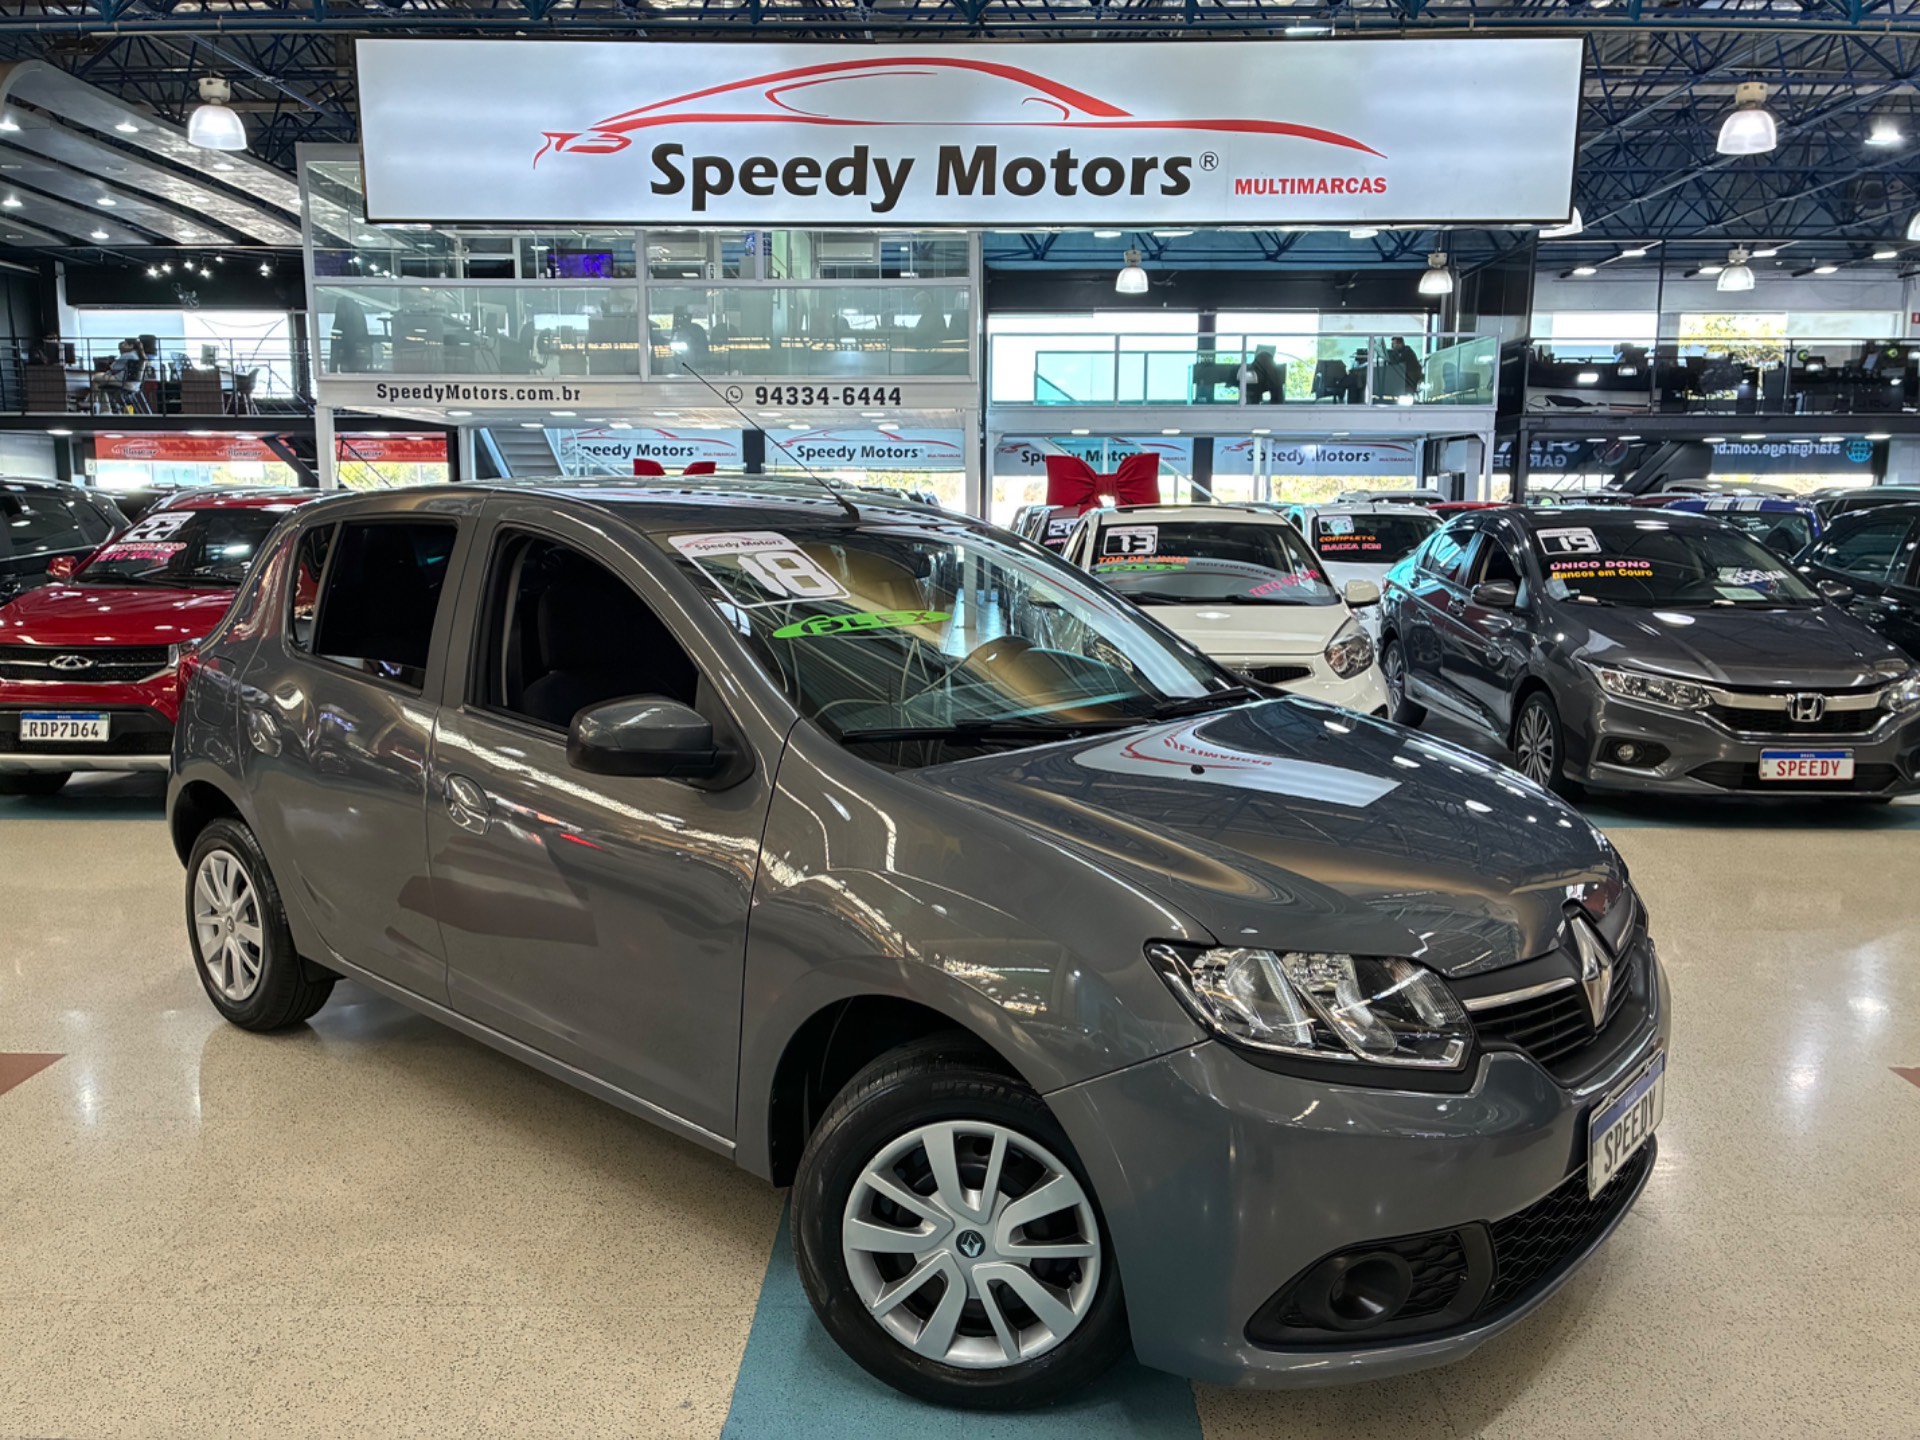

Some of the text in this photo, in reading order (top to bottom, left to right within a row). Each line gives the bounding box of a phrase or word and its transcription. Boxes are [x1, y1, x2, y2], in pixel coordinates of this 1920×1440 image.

[650, 142, 915, 212] Speedy
[1234, 176, 1388, 195] MULTIMARCAS
[376, 383, 581, 403] SpeedyMotors.com.br
[755, 386, 902, 406] 94334-6444
[796, 444, 857, 461] Speedy
[124, 519, 183, 540] 22
[1119, 534, 1155, 553] 13
[1558, 535, 1598, 552] 19
[1098, 555, 1125, 565] TOP
[1126, 555, 1146, 564] DE
[1604, 560, 1651, 569] DONO
[737, 550, 841, 598] 18
[1552, 568, 1654, 580] Bancos em Couro
[1248, 580, 1282, 597] TETO
[800, 611, 931, 634] FLEX
[28, 721, 100, 738] RDP7D64
[1776, 760, 1841, 777] SPEEDY
[1603, 1086, 1657, 1174] SPEEDY
